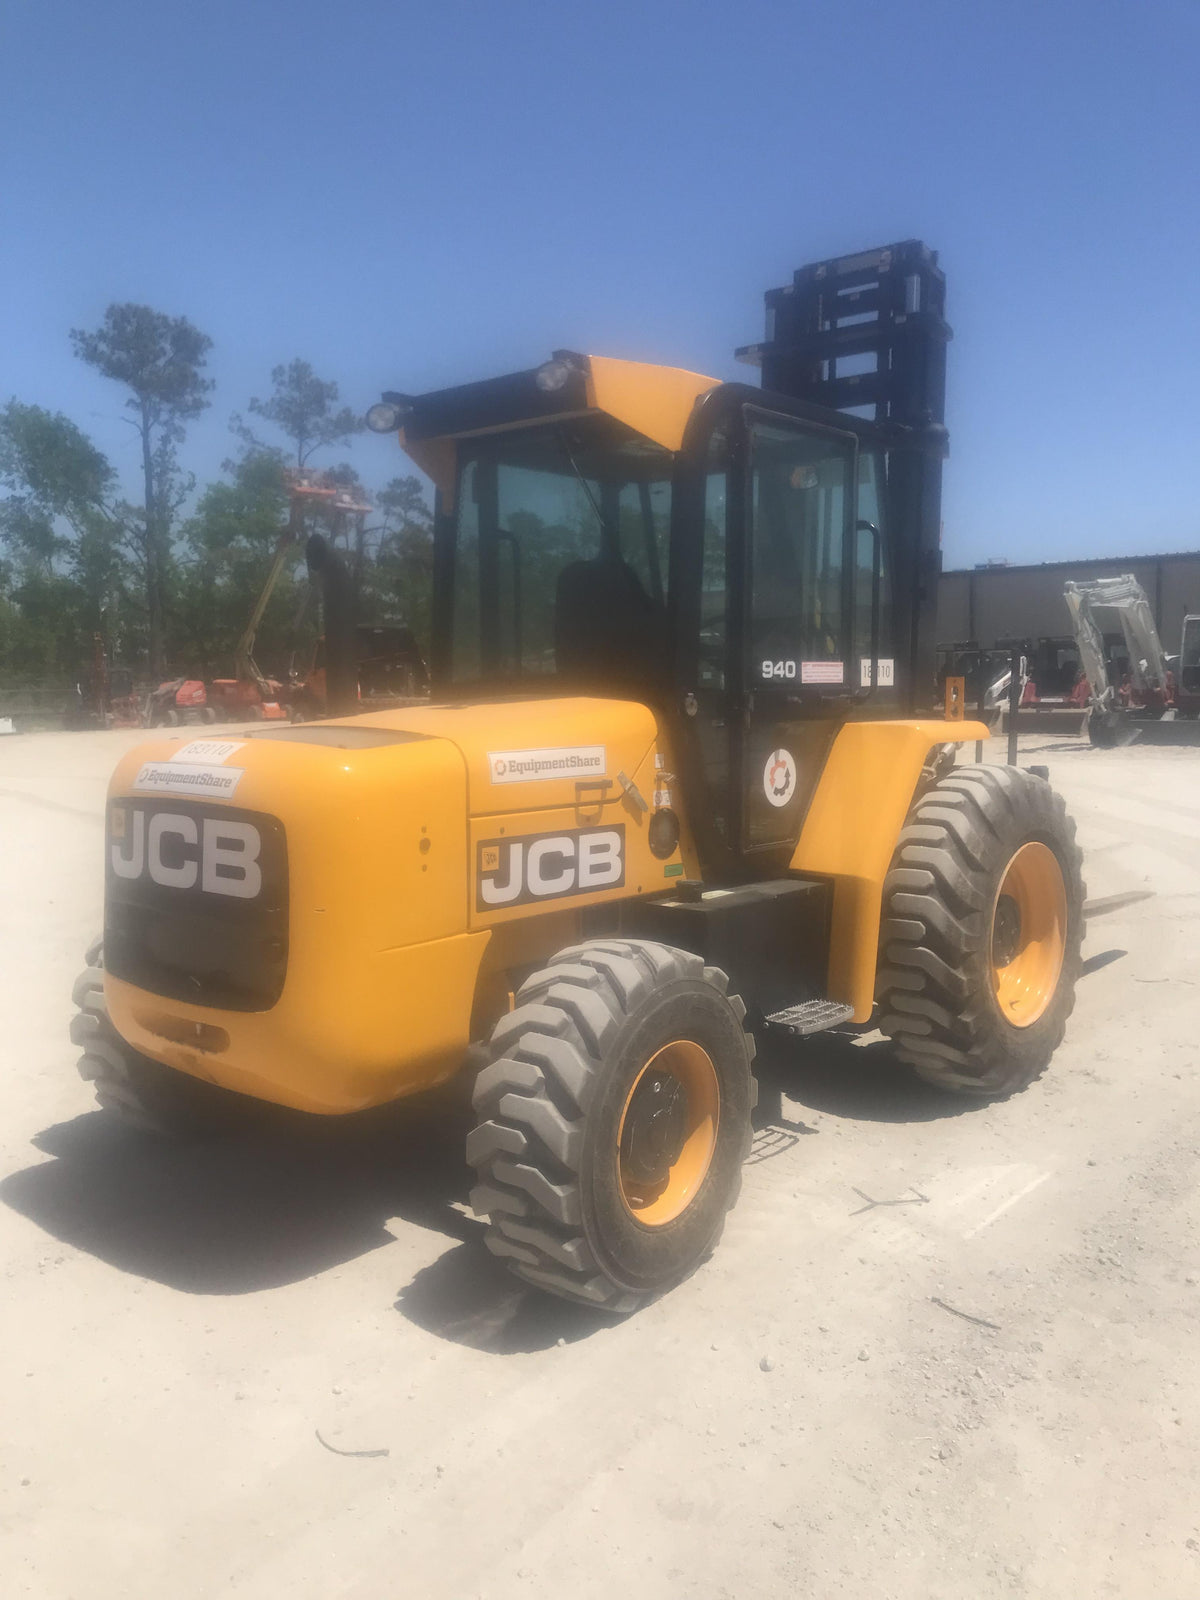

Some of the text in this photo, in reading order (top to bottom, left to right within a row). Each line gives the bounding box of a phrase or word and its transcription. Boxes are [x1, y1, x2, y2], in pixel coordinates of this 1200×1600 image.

[762, 660, 796, 679] 940
[508, 756, 601, 775] EquipmentShare
[147, 769, 234, 788] EquipmentShare
[111, 810, 262, 899] JCB
[481, 831, 622, 904] JCB
